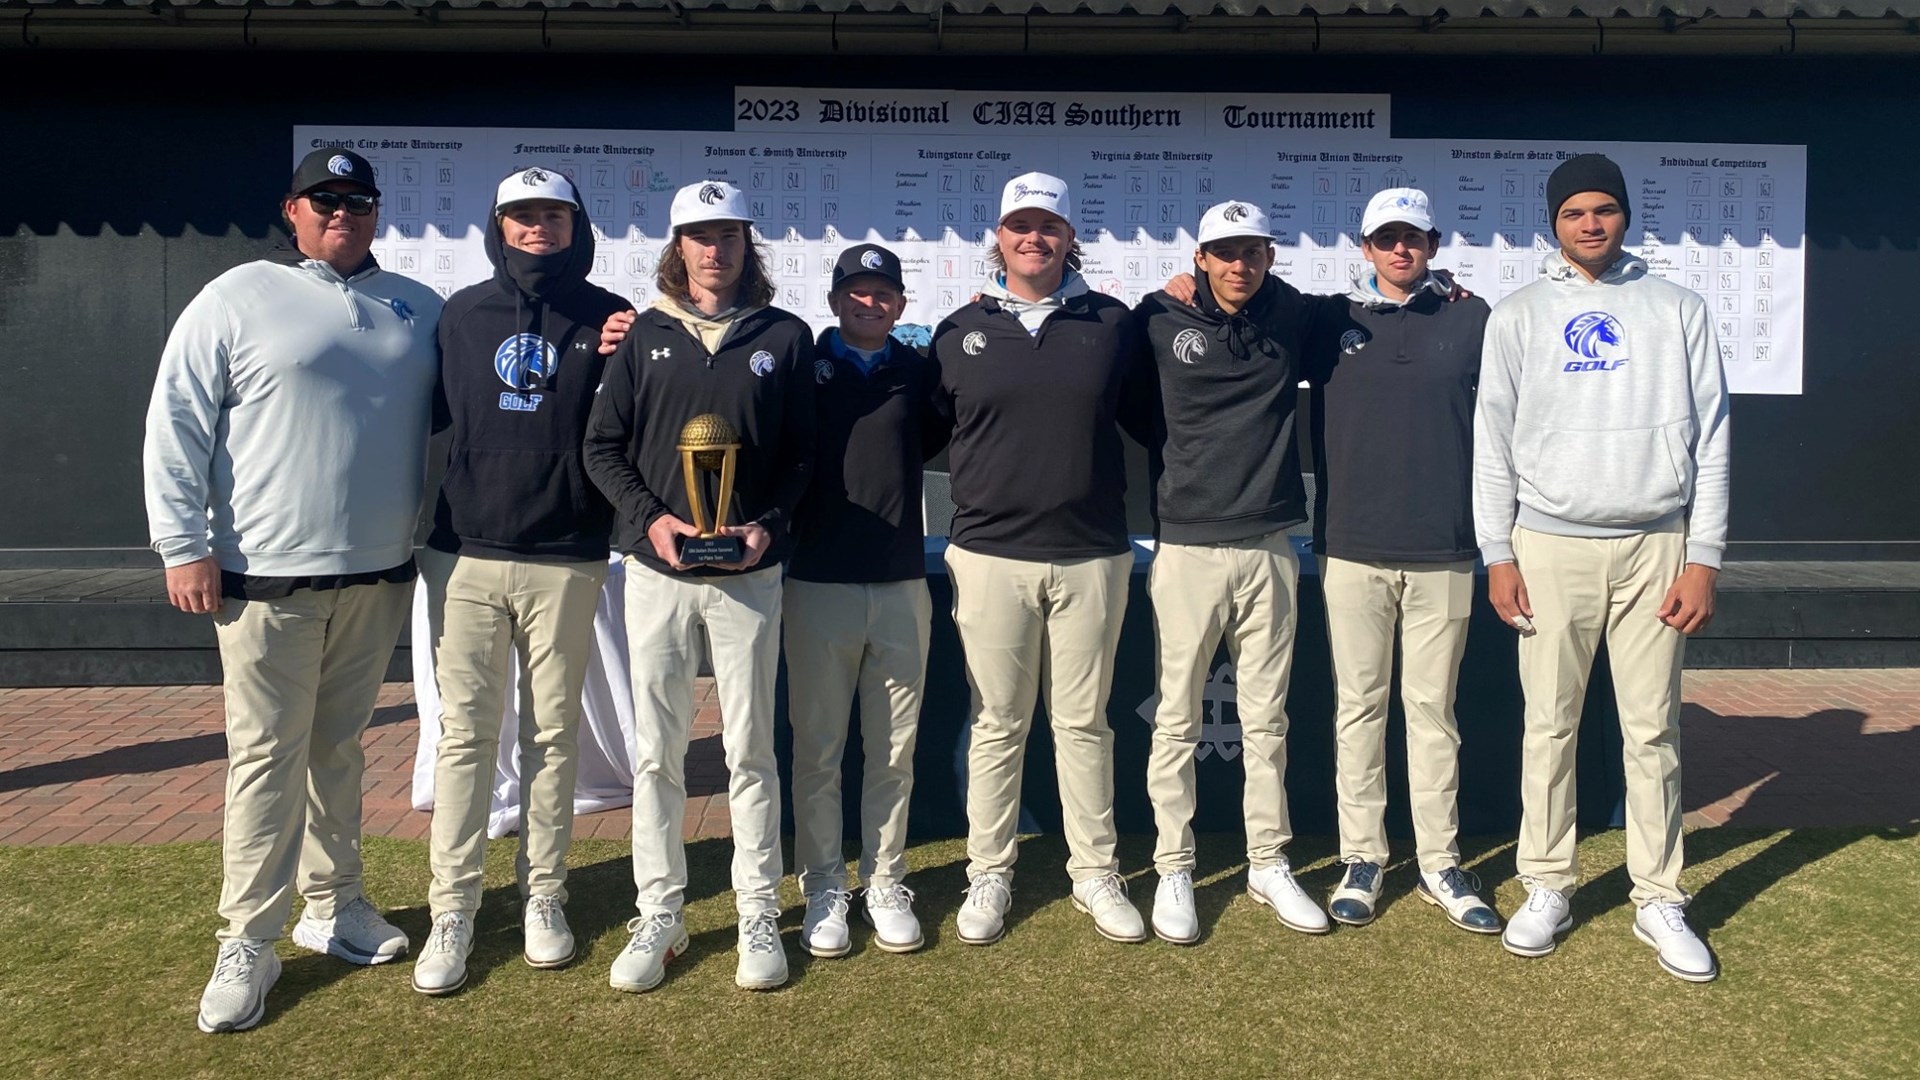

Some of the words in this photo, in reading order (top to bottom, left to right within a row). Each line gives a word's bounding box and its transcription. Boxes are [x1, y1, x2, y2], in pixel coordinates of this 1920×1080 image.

[737, 98, 800, 121] 2023
[819, 98, 949, 124] Divisional
[973, 101, 1056, 126] CIAA
[1064, 102, 1181, 131] Southern
[1223, 104, 1375, 129] Tournament
[310, 138, 354, 149] Elizabeth
[357, 138, 378, 150] City
[381, 139, 408, 149] State
[410, 139, 462, 150] University
[513, 143, 571, 155] Fayetteville
[573, 144, 600, 154] State
[603, 144, 655, 156] University
[705, 145, 745, 157] Johnson
[749, 147, 760, 157] C.
[763, 147, 794, 158] Smith
[796, 147, 847, 160] University
[917, 149, 973, 161] Livingstone
[976, 150, 1012, 161] College
[1091, 150, 1131, 162] Virginia
[1133, 151, 1160, 161] State
[1162, 151, 1213, 162] University
[1277, 152, 1317, 163] Virginia
[1319, 152, 1350, 162] Union
[1352, 152, 1403, 164] University
[1451, 149, 1491, 160] Winston
[1493, 150, 1525, 160] Salem
[1527, 150, 1553, 160] State
[1659, 156, 1708, 168] Individual
[1711, 157, 1767, 169] Competitors
[1563, 359, 1630, 372] GOLF
[499, 391, 543, 412] GOLF
